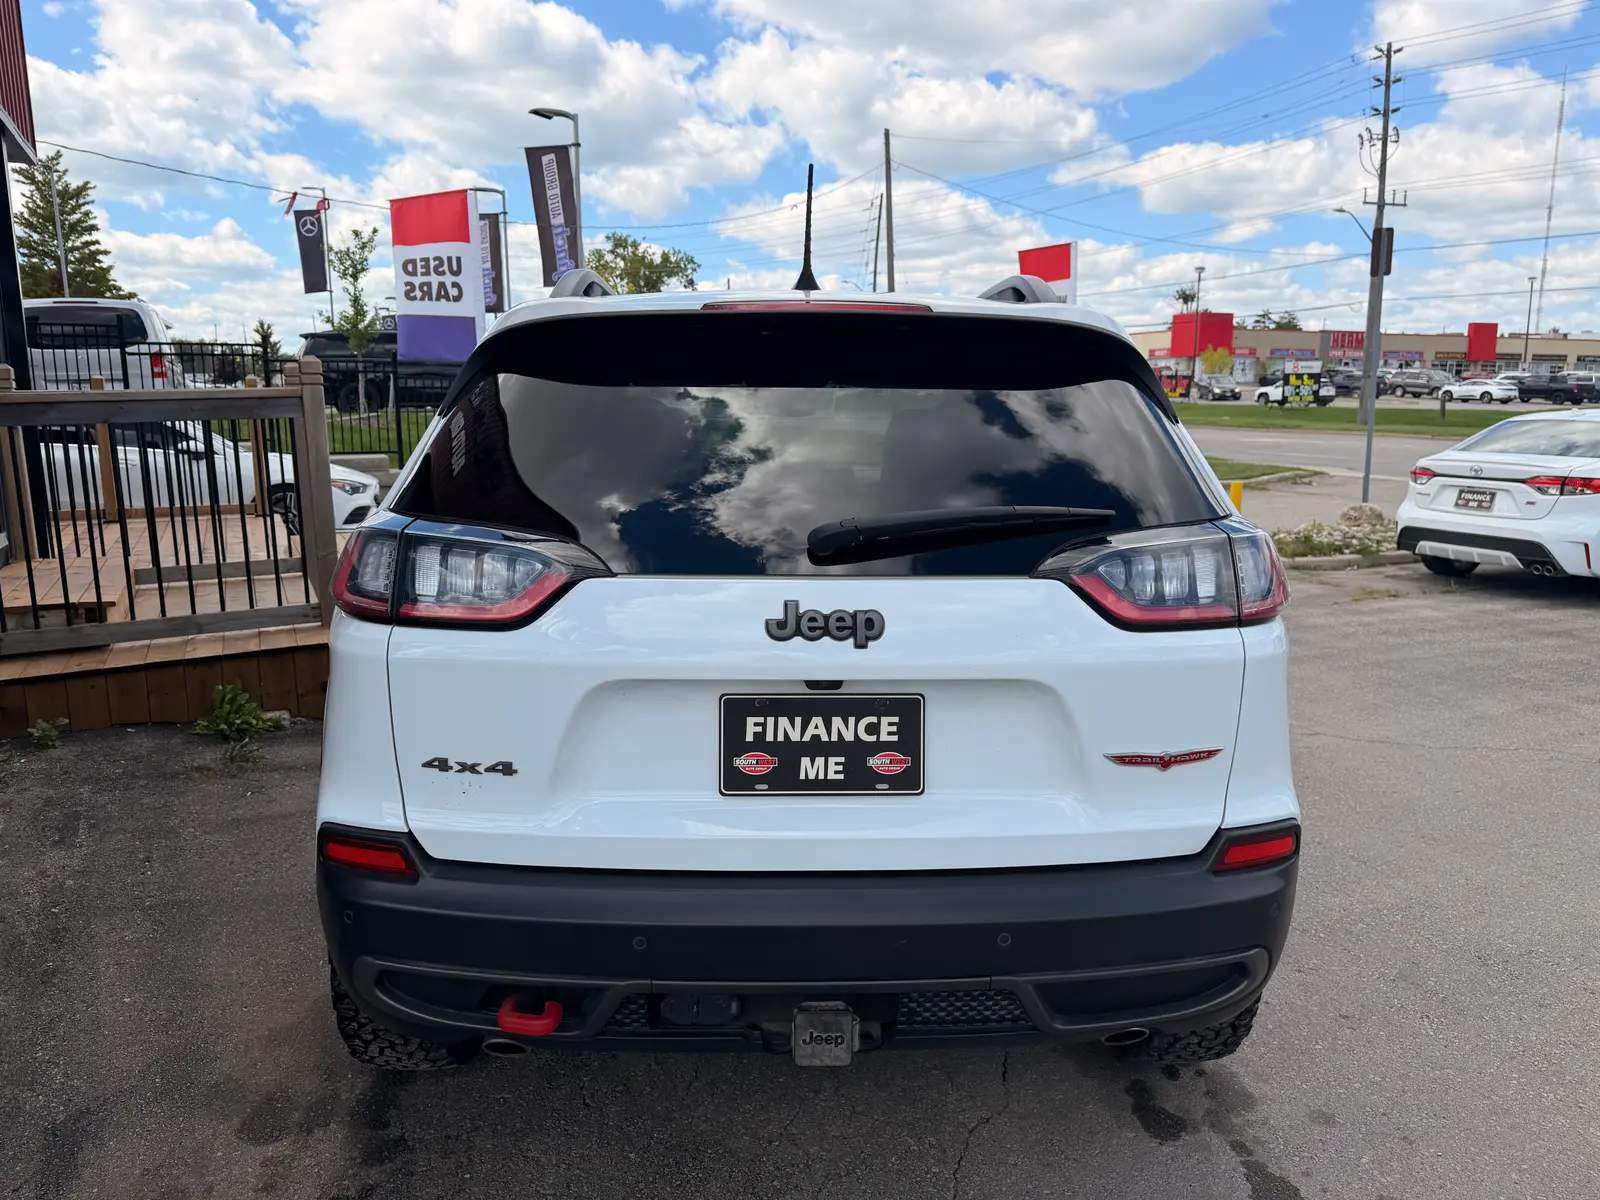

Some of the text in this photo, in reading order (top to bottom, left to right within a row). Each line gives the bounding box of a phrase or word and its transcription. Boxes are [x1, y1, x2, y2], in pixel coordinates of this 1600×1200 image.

[1460, 492, 1491, 502] FINANCE
[764, 600, 885, 649] Jeep
[745, 716, 899, 742] FINANCE
[421, 756, 518, 776] 4x4
[1171, 752, 1209, 762] HAWK
[799, 756, 845, 780] ME
[802, 1030, 845, 1047] Jeep
